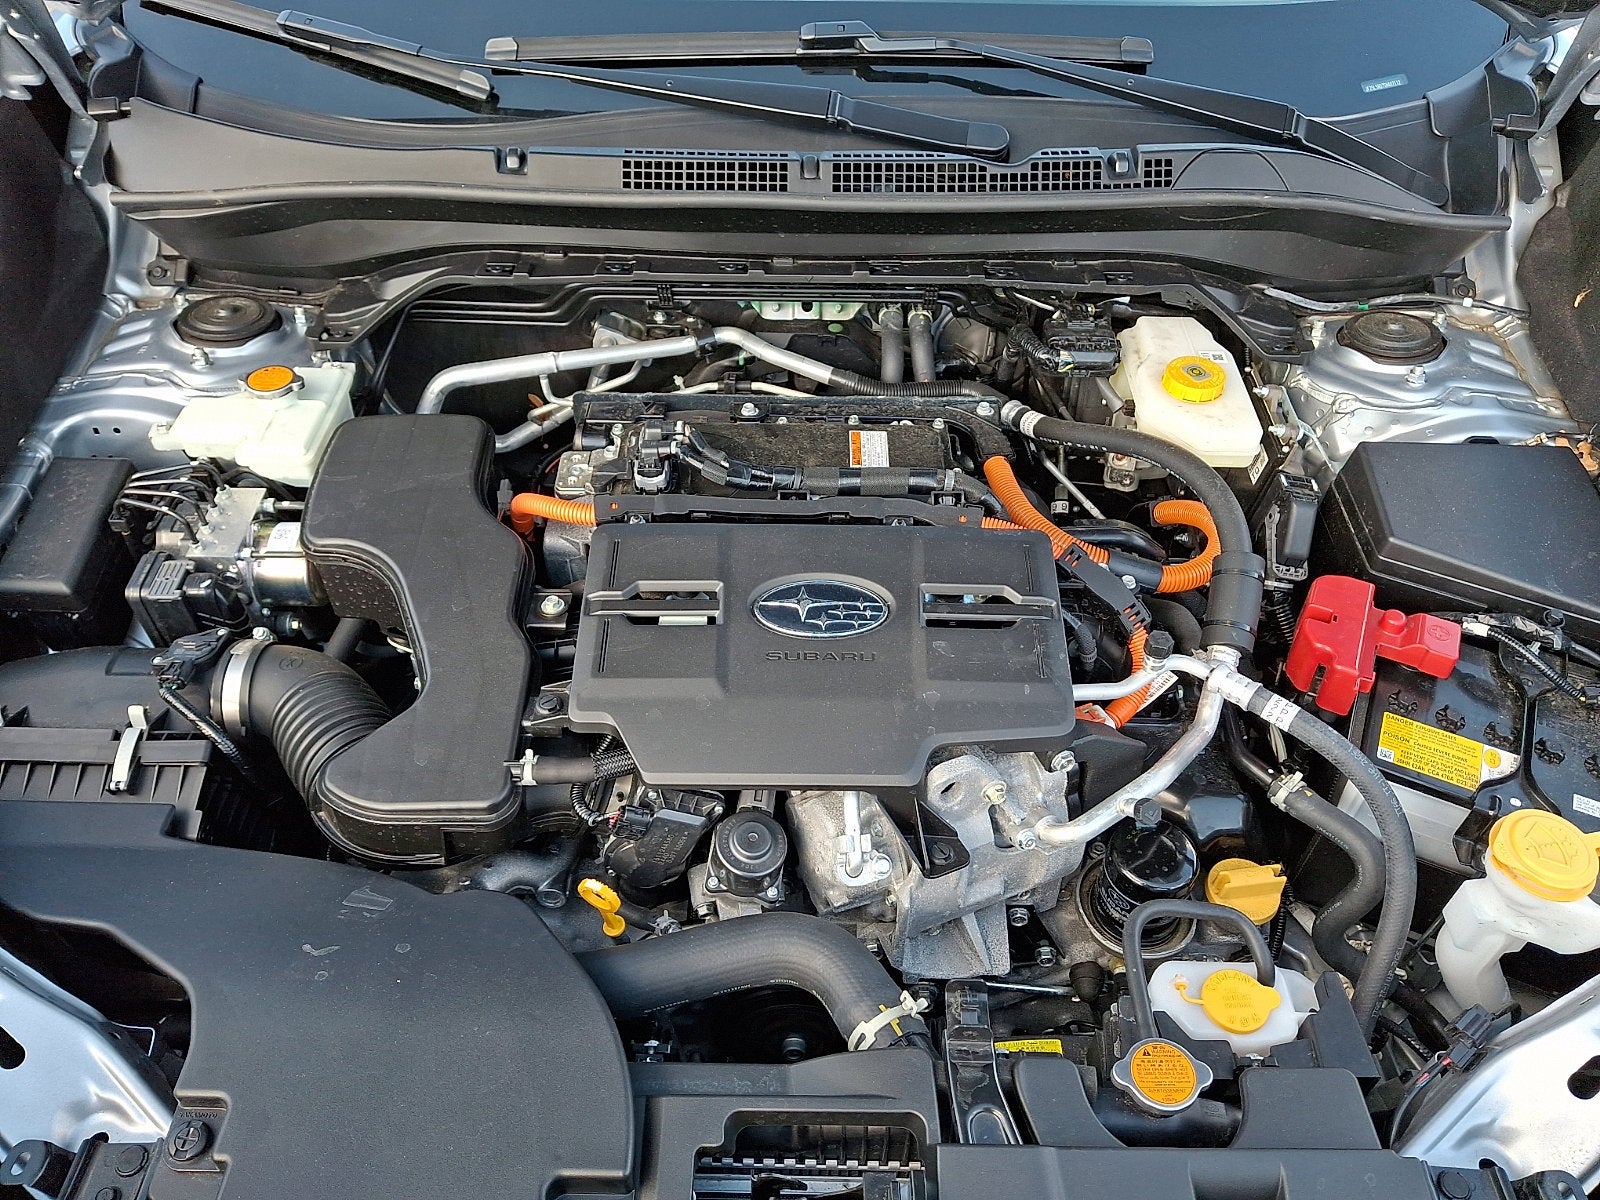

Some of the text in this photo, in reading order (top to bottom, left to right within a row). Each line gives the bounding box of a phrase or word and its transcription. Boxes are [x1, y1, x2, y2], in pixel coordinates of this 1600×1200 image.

[765, 651, 877, 662] SUBARU
[1385, 713, 1414, 727] DANGER
[1382, 730, 1410, 743] POISON
[1426, 768, 1440, 776] CCA
